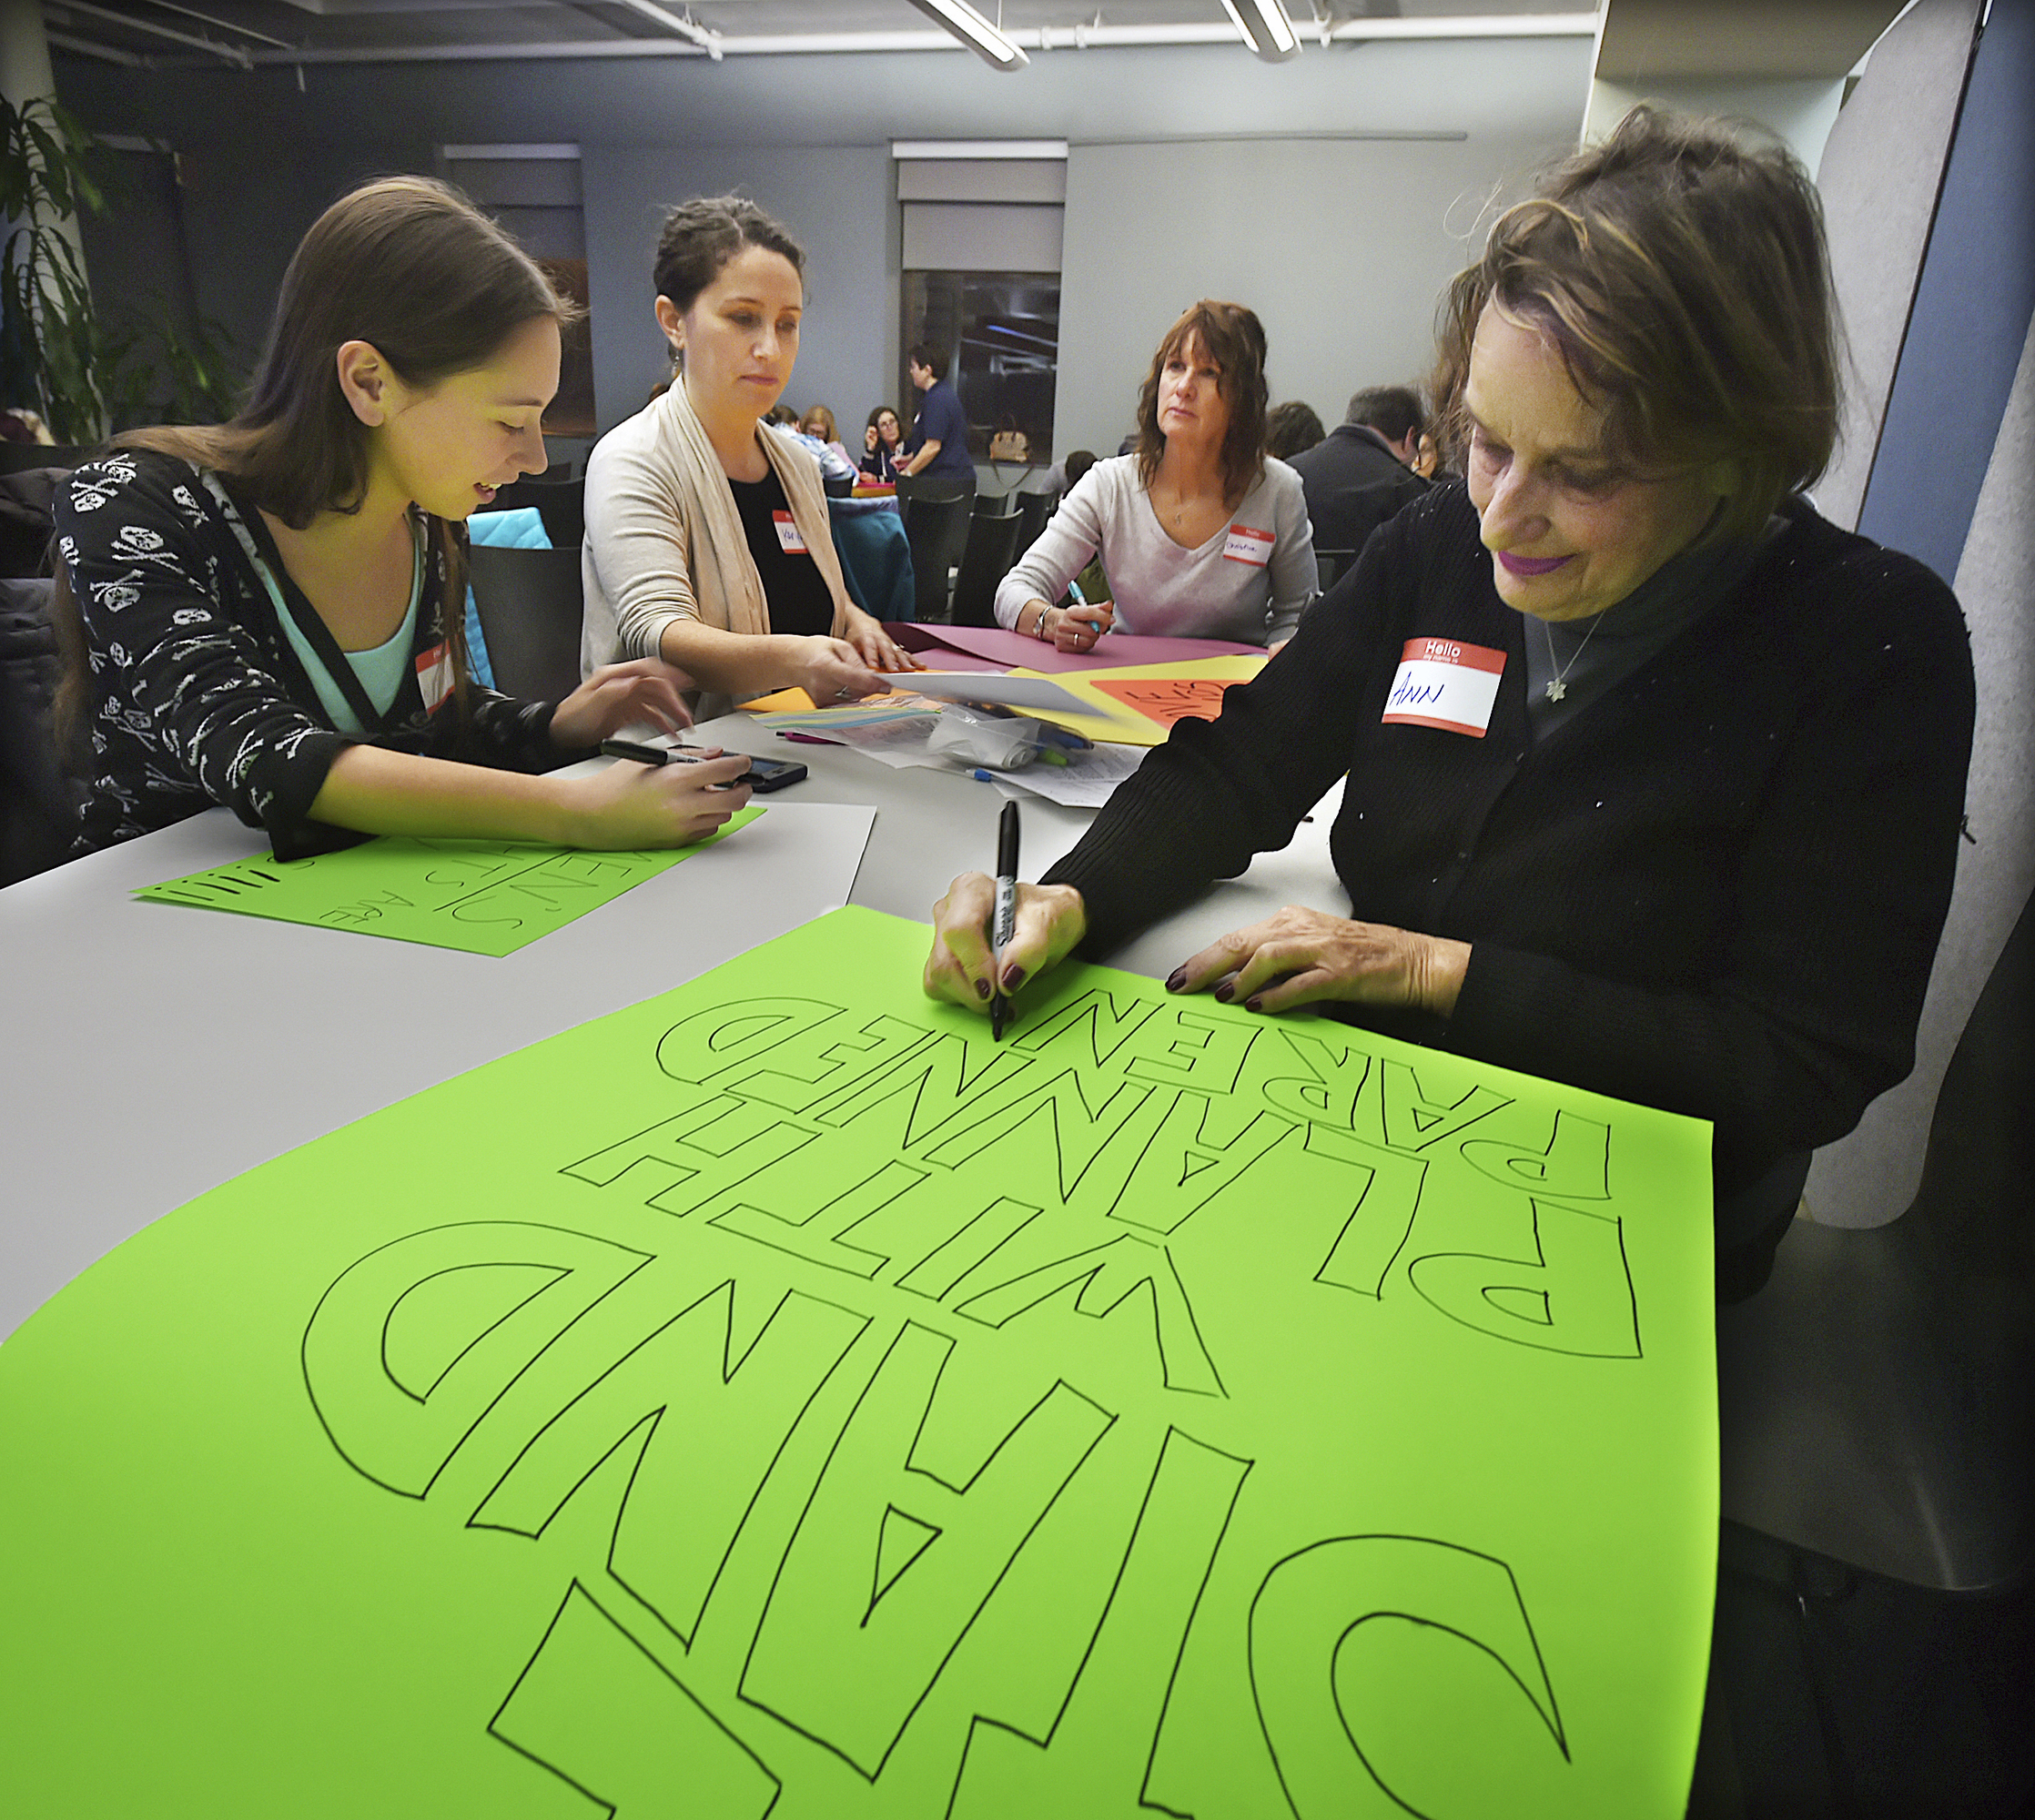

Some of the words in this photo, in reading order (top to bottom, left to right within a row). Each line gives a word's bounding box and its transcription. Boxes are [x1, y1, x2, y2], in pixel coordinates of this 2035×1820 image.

[1389, 671, 1445, 706] ANN
[1425, 640, 1462, 658] Hello
[319, 889, 414, 925] ARE
[1009, 987, 1612, 1200] PAREN
[655, 996, 1644, 1359] PLANNED
[559, 1093, 1230, 1399] WITH
